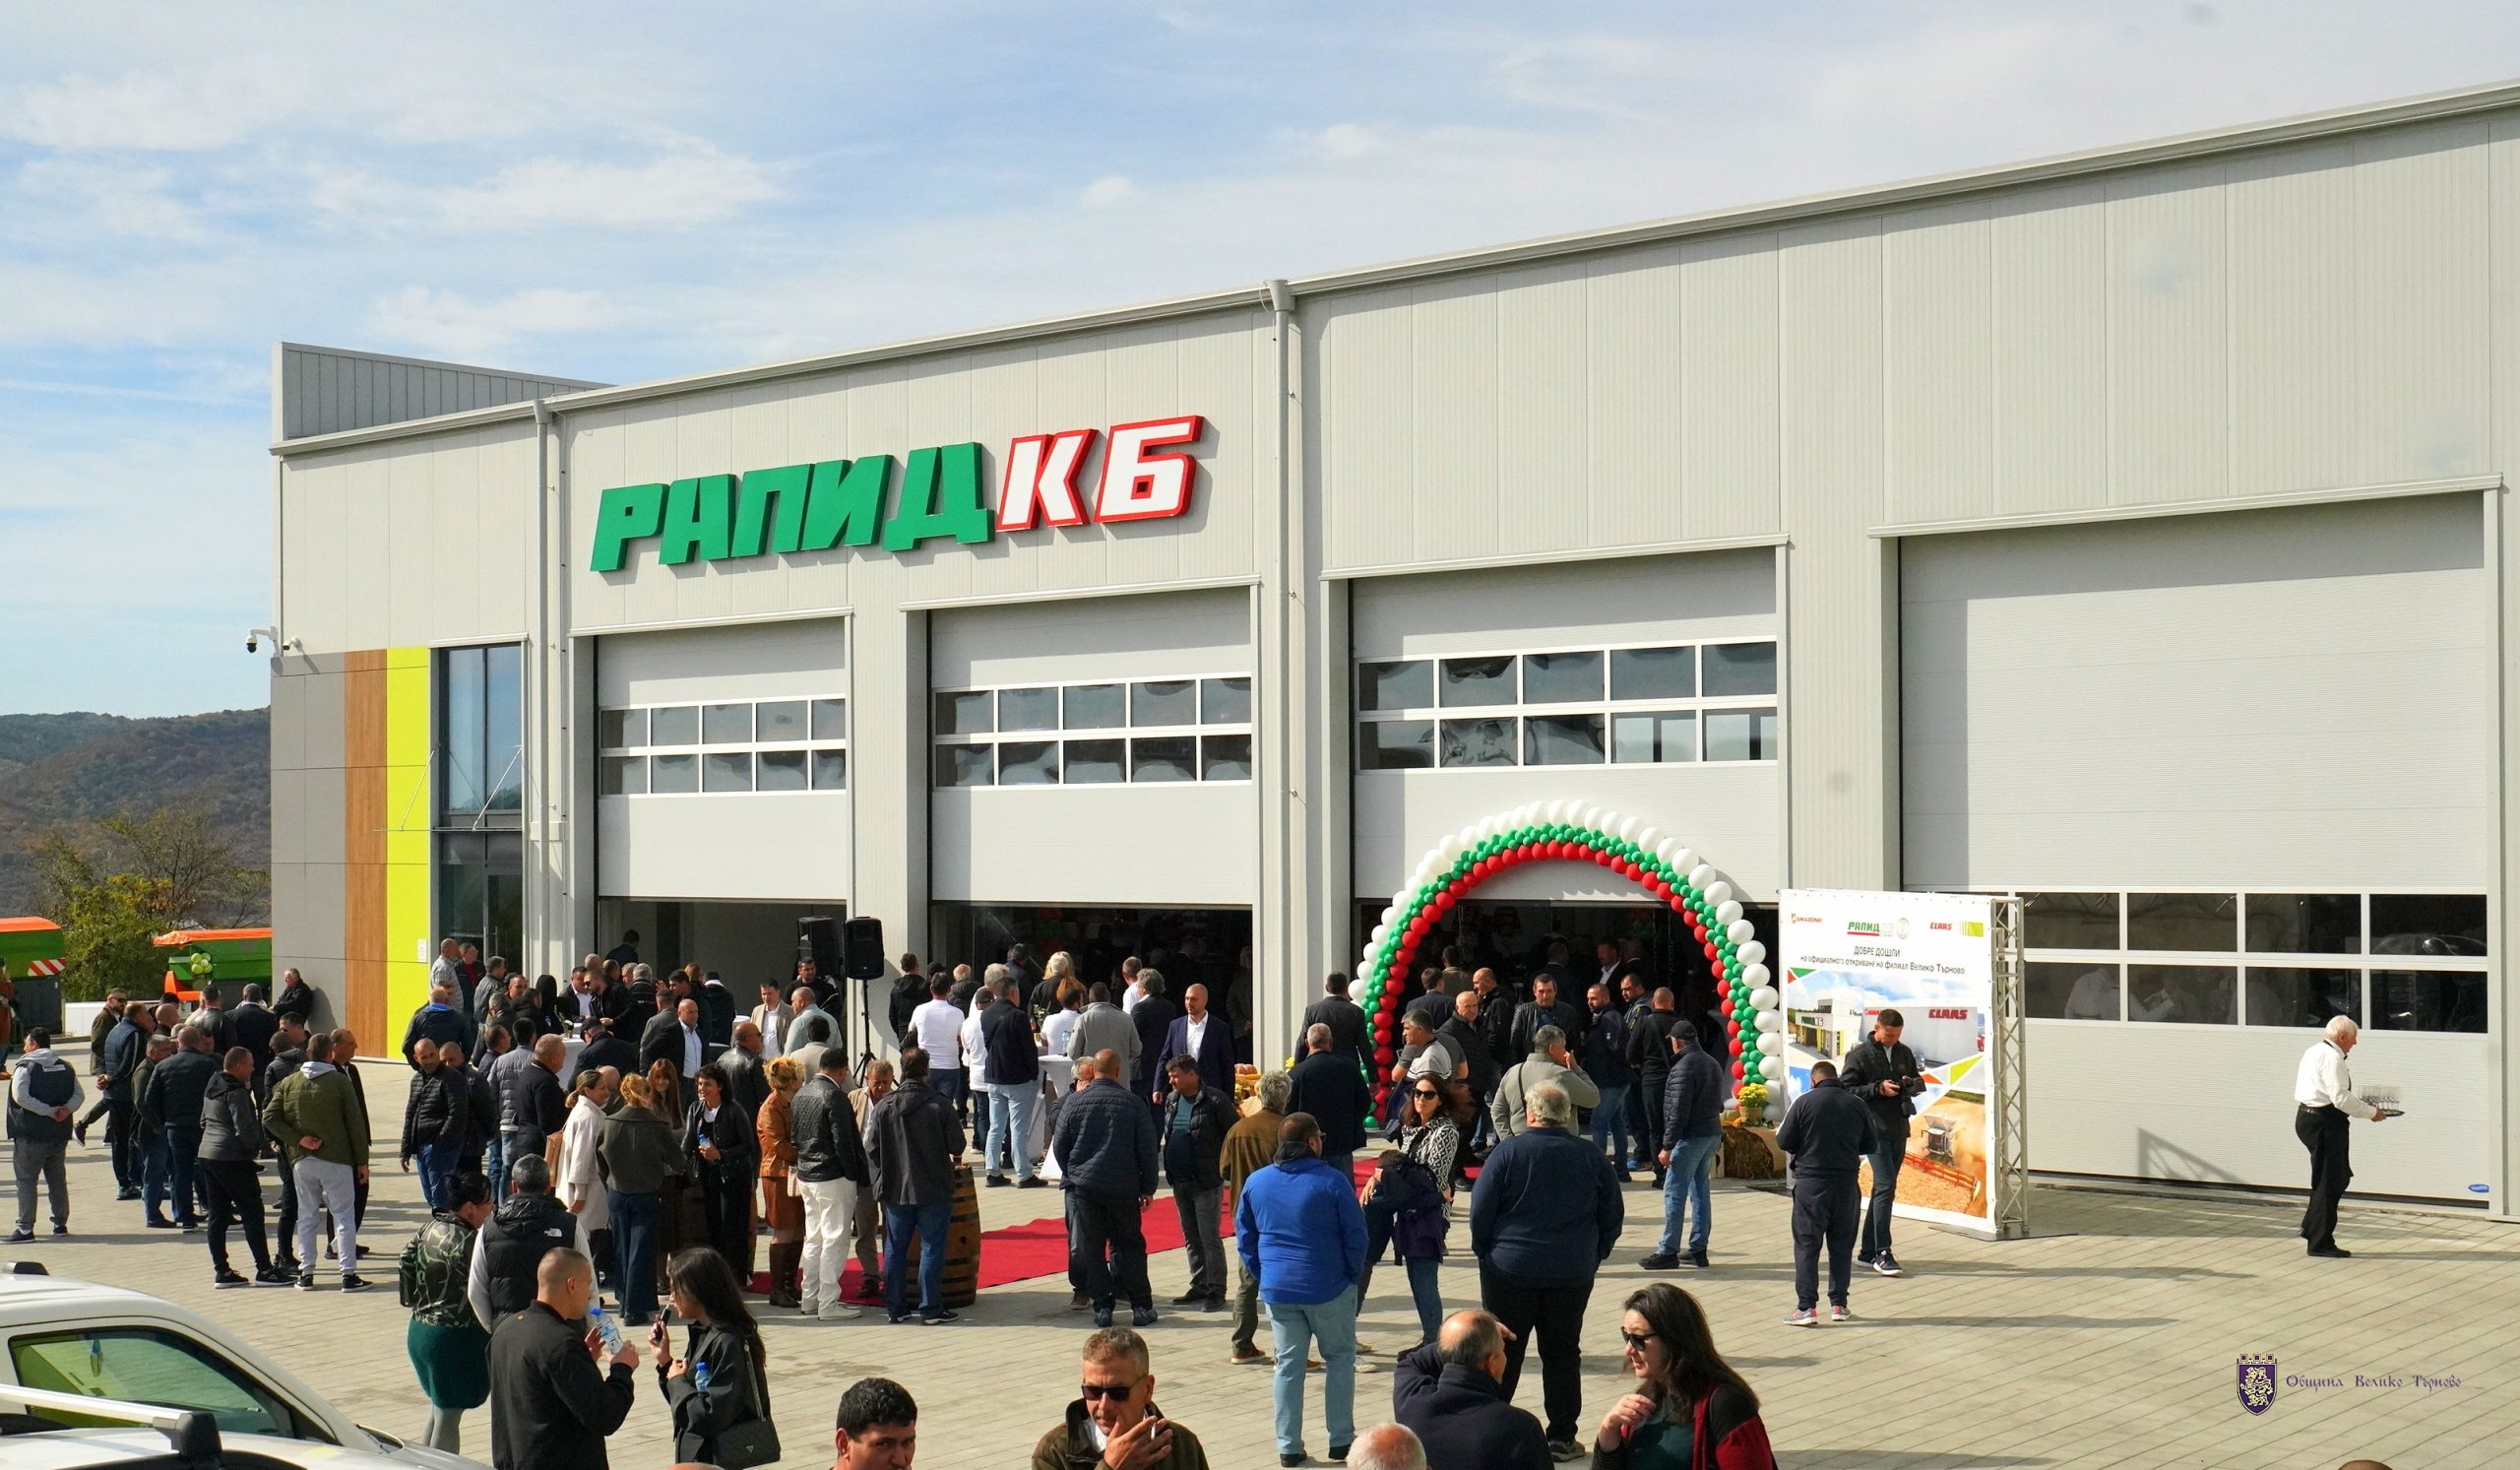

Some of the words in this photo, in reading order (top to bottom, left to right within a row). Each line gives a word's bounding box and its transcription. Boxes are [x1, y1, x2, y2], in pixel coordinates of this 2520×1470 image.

[591, 442, 995, 572] РАПИД
[996, 415, 1205, 533] КБ
[1848, 921, 1880, 932] РАПИД
[1929, 922, 1953, 930] CLAAS
[1854, 946, 1874, 956] ДОБРЕ
[1875, 947, 1901, 958] ДОШЛИ
[1846, 959, 1875, 968] откриване
[1884, 961, 1909, 971] филиал
[1910, 961, 1934, 972] Велико
[1936, 963, 1965, 975] Търново
[1928, 1008, 1968, 1020] CLAAS
